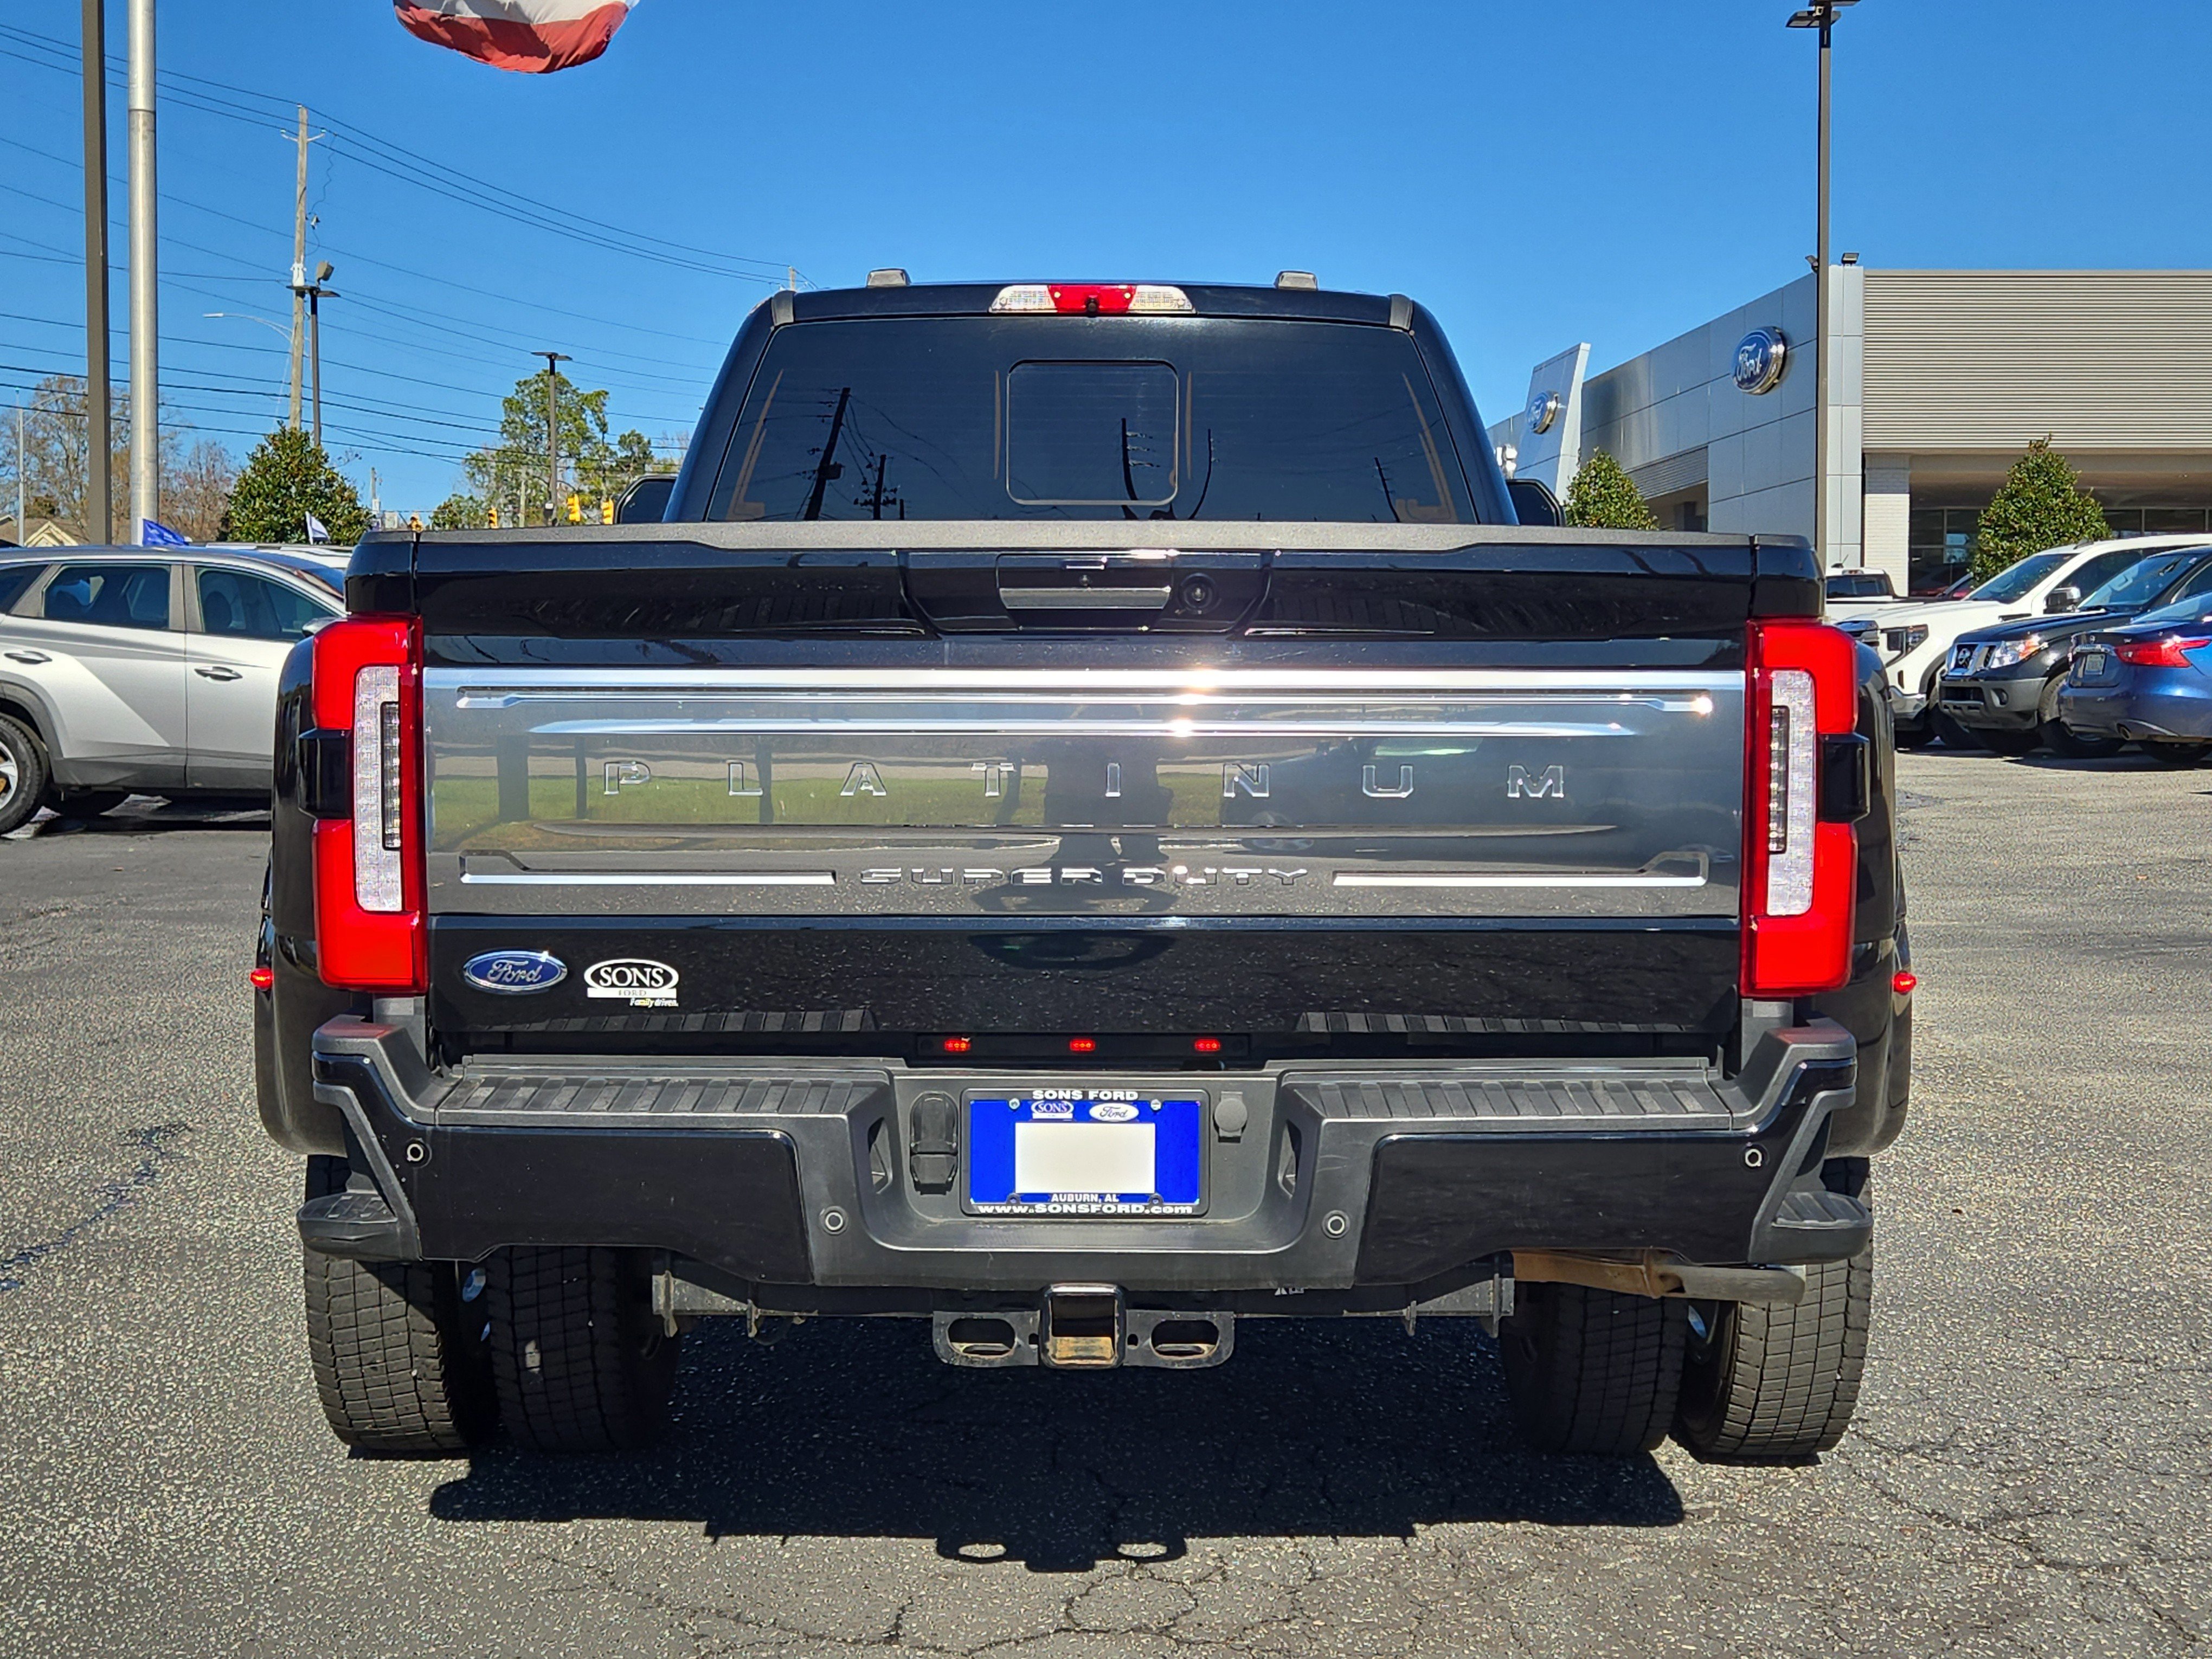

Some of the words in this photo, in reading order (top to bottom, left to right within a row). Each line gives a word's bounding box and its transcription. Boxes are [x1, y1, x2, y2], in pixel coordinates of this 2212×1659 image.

[1737, 343, 1762, 381] Ford
[603, 761, 1564, 798] PLATINUM
[860, 867, 1103, 885] SUPER
[1122, 866, 1308, 885] DUTY
[487, 959, 543, 982] Ford
[599, 967, 664, 987] SONS
[1032, 1090, 1083, 1100] SONS
[1088, 1090, 1139, 1101] FORD
[1038, 1103, 1068, 1113] SONS
[1099, 1106, 1129, 1118] Ford
[1051, 1193, 1102, 1204] AUBURN,
[1104, 1193, 1120, 1203] AL
[977, 1204, 1193, 1214] www.SONSFORD.com
